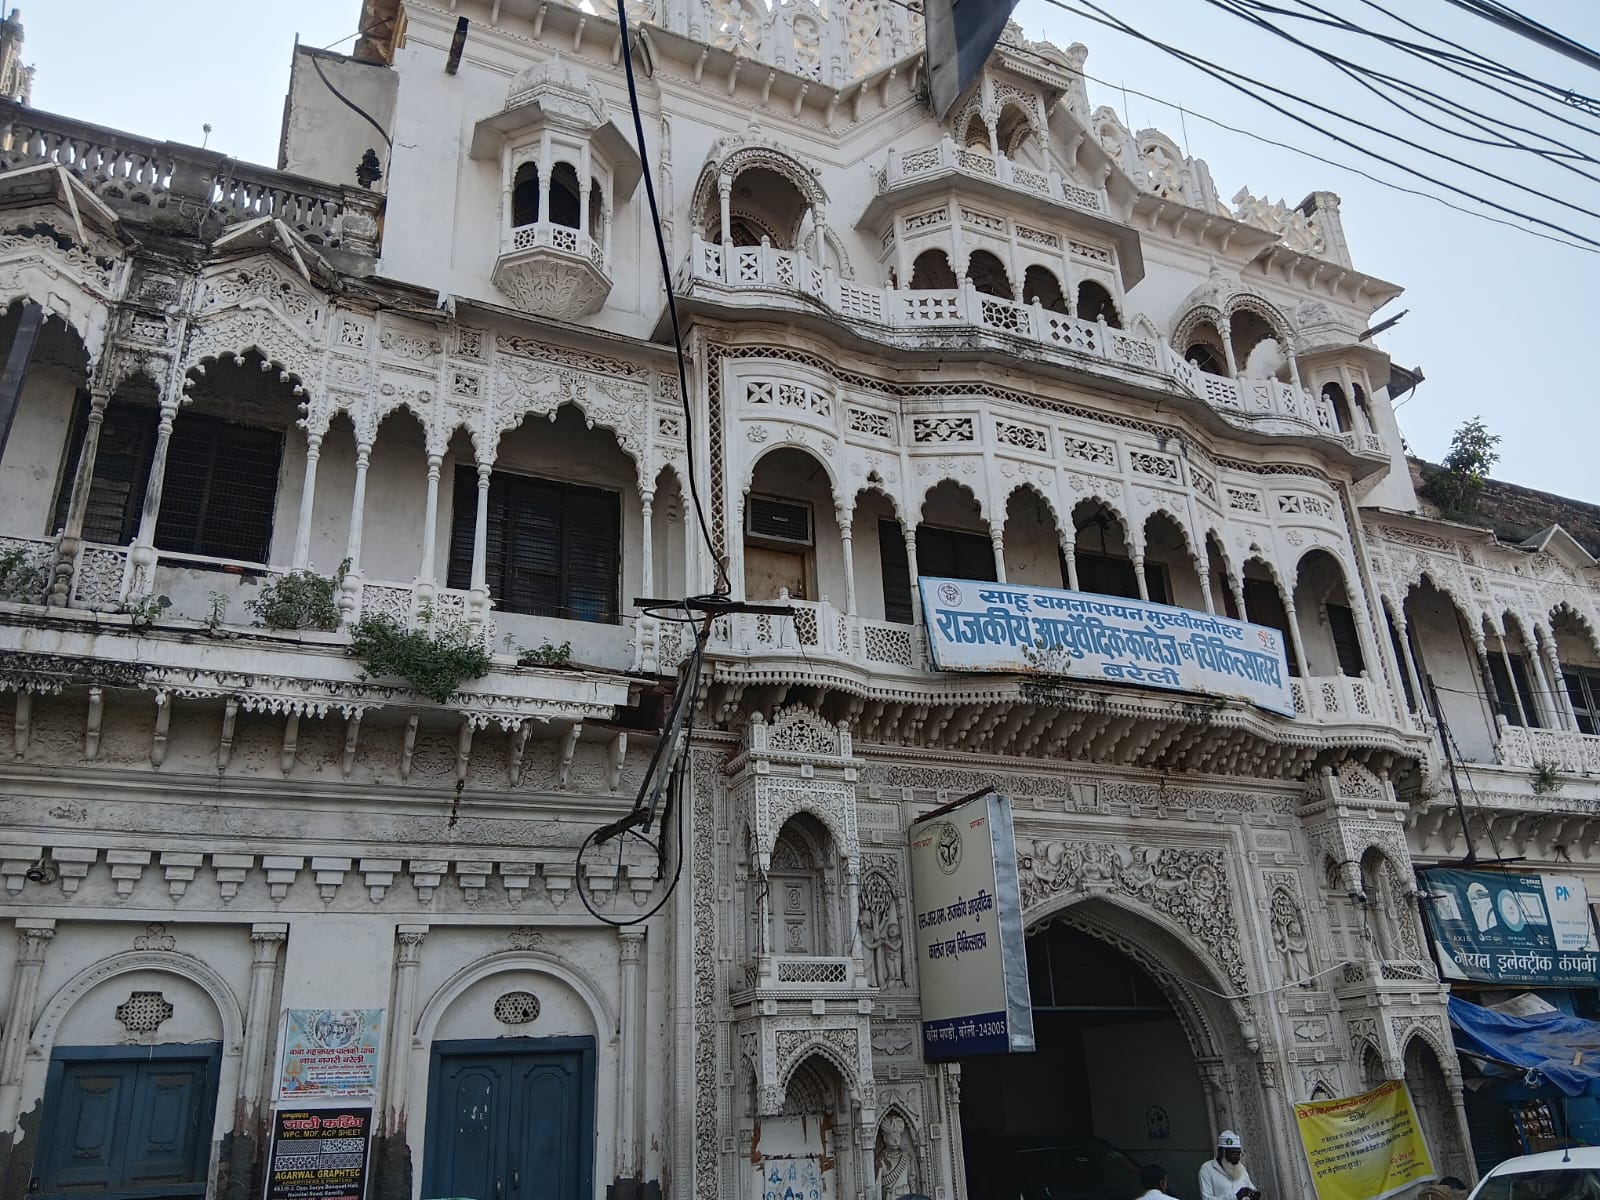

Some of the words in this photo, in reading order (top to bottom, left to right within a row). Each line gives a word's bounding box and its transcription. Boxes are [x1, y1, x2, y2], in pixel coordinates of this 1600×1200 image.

[979, 589, 1031, 613] साहू
[1033, 594, 1144, 621] रामनारायन
[1145, 609, 1243, 640] मुरलीमनोहर
[935, 607, 1033, 648] राजकीय
[1031, 613, 1127, 660] आयुर्वेदिक
[1121, 624, 1182, 666] कालेज
[1178, 639, 1194, 661] एवं
[1188, 633, 1282, 689] चिकित्सालय
[1101, 661, 1180, 686] बरेली
[947, 895, 967, 921] राजकीय
[343, 1055, 364, 1064] बरेली
[282, 1115, 321, 1129] जाली
[337, 1128, 362, 1136] SHEET
[275, 1171, 315, 1180] AGARWAL
[317, 1168, 361, 1178] GRAPHTEC
